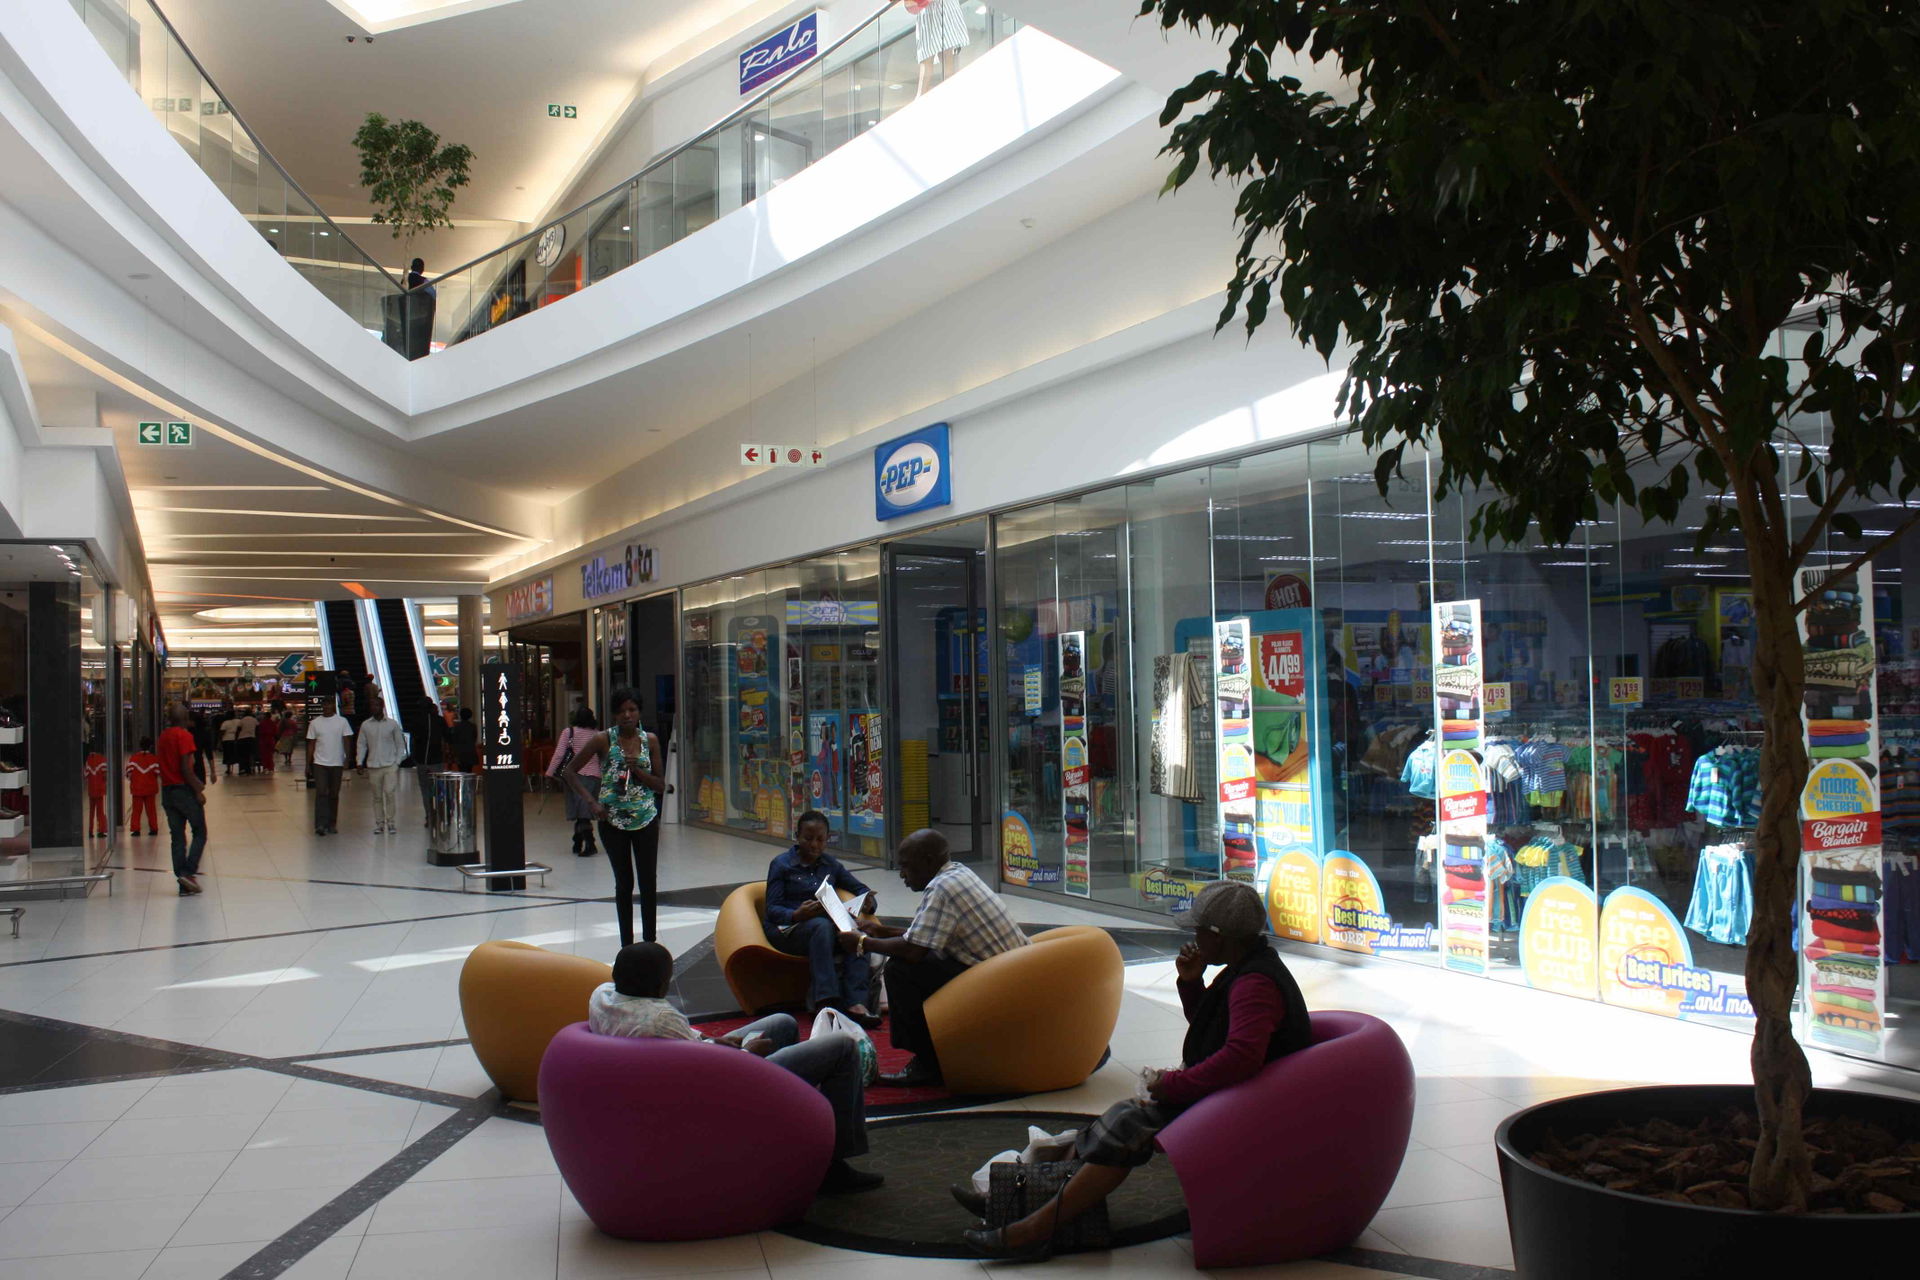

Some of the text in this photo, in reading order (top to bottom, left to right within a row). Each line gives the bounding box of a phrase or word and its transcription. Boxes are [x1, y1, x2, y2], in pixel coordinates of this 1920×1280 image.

[742, 21, 816, 79] Ralo
[884, 456, 924, 494] PEP
[581, 557, 623, 599] Telkom
[496, 754, 513, 765] m
[1820, 777, 1859, 794] MORE
[1444, 796, 1478, 812] Bargain
[1816, 800, 1864, 813] CHEERFUL
[1004, 828, 1028, 847] free
[1811, 819, 1870, 839] Bargain
[1820, 832, 1864, 848] Blankets!
[1146, 878, 1186, 899] Best prices
[1279, 870, 1311, 891] free
[1326, 873, 1370, 898] free
[1273, 888, 1318, 915] CLUB
[1279, 913, 1313, 932] card
[1334, 905, 1391, 933] Best prices
[1539, 906, 1583, 935] free
[1370, 926, 1433, 948] ...and more!
[1608, 915, 1672, 949] free
[1531, 930, 1593, 964] CLUB
[1538, 959, 1586, 985] card
[1627, 957, 1712, 994] Best prices
